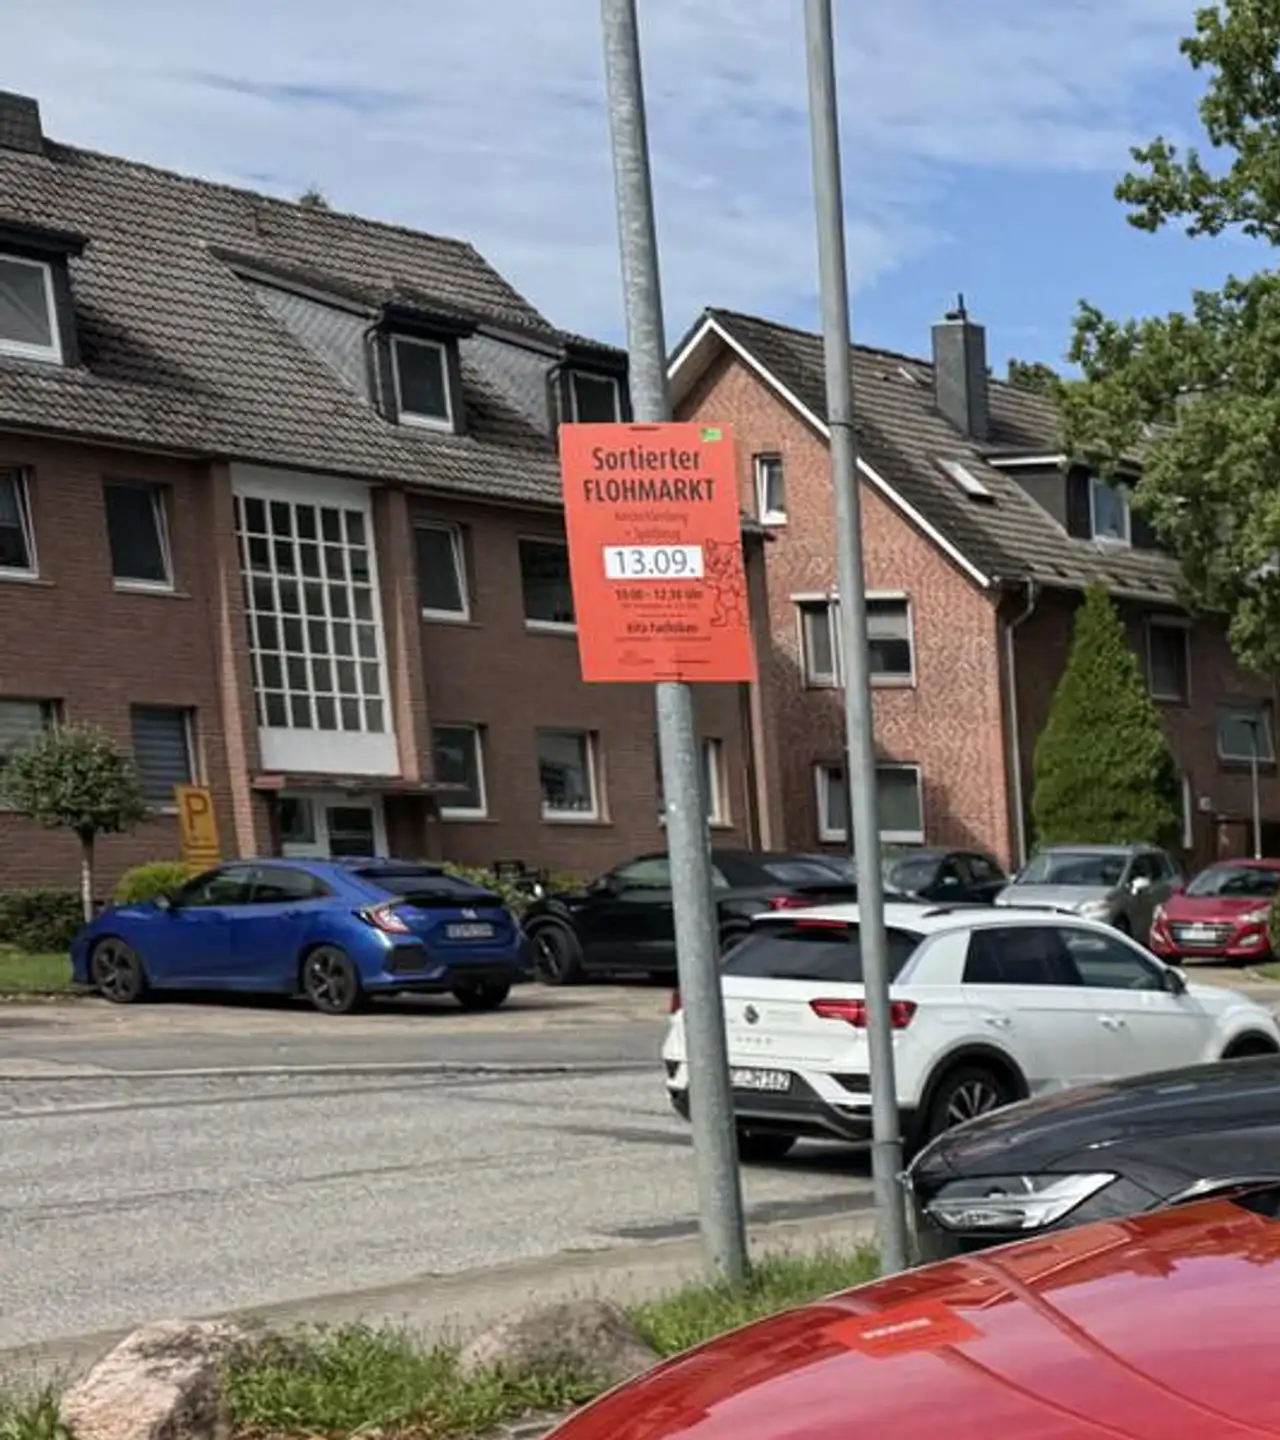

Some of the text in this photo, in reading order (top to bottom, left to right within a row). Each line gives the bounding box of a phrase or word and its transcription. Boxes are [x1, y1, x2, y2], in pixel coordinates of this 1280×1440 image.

[591, 444, 700, 471] Sortierter
[583, 478, 715, 502] FLOHMARKT
[615, 549, 696, 575] 13.09.
